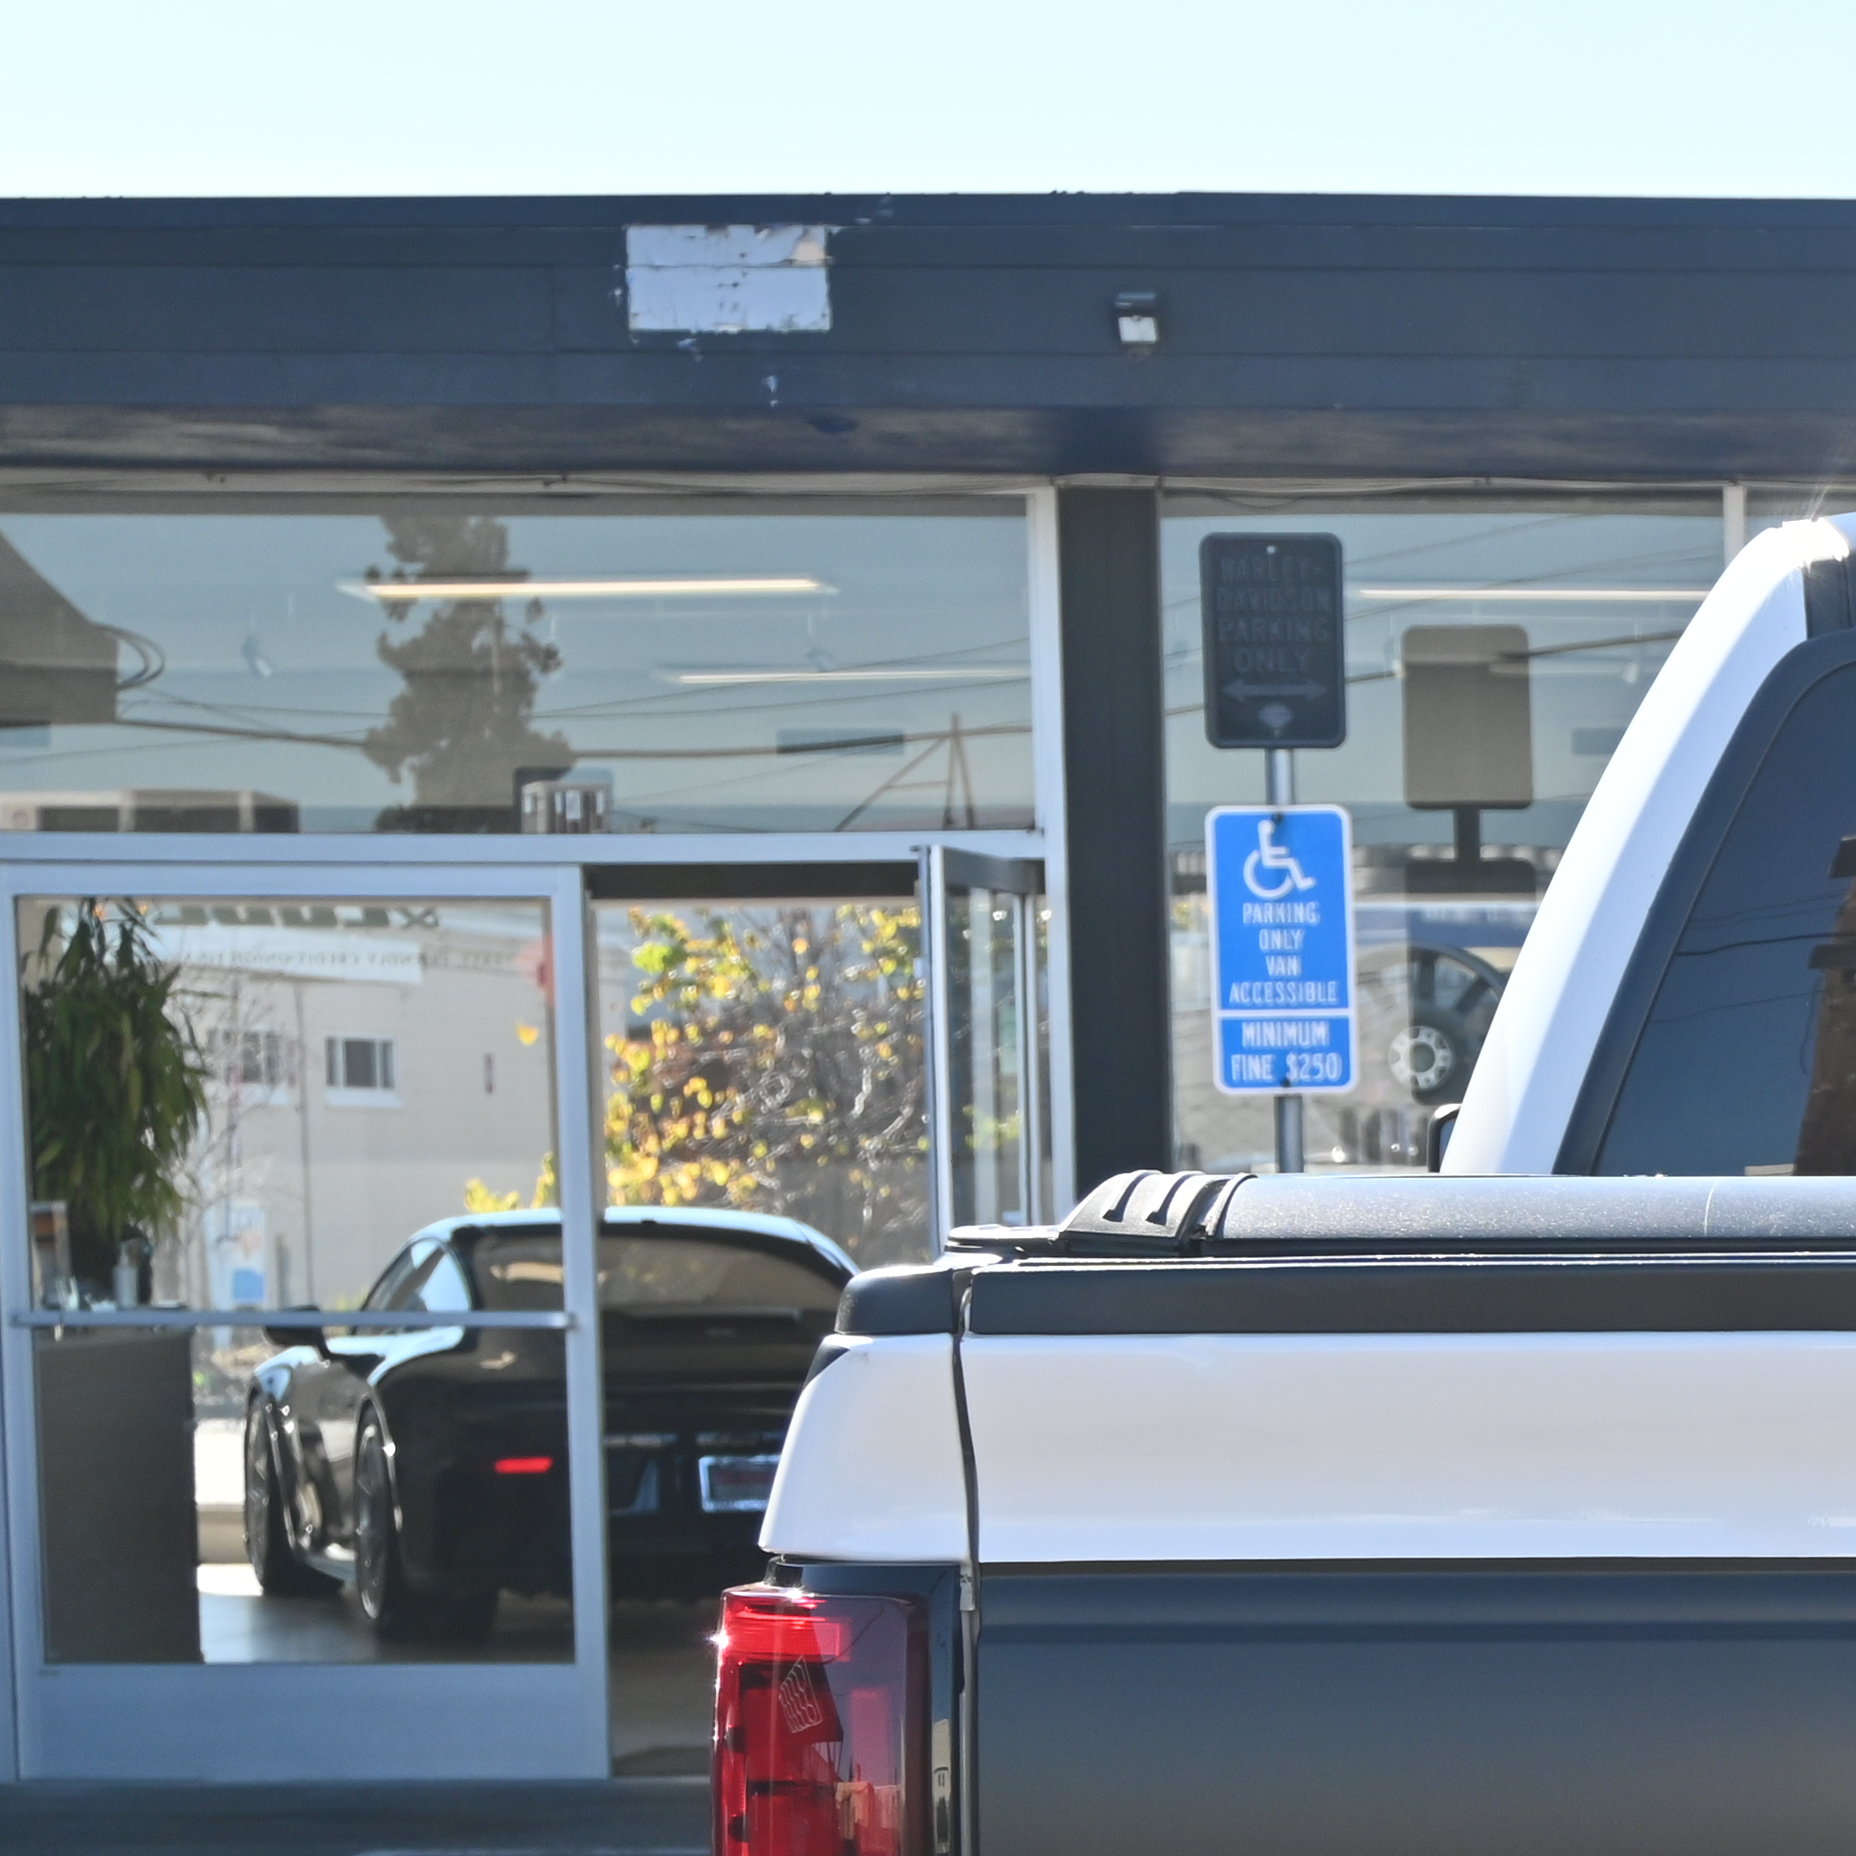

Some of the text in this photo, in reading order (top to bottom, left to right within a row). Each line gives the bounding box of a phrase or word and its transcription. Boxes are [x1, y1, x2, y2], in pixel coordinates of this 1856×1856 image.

[1217, 586, 1333, 612] DAVIDSON
[1218, 617, 1331, 643] PARKING
[1234, 649, 1309, 673] ONLY
[1242, 902, 1319, 925] PARKING
[1258, 929, 1304, 950] ONLY
[1265, 955, 1300, 976] VAN
[1229, 981, 1338, 1004] ACCESSIBLE
[1241, 1021, 1329, 1047] MINIMUM
[1231, 1052, 1342, 1081] FINE $250
